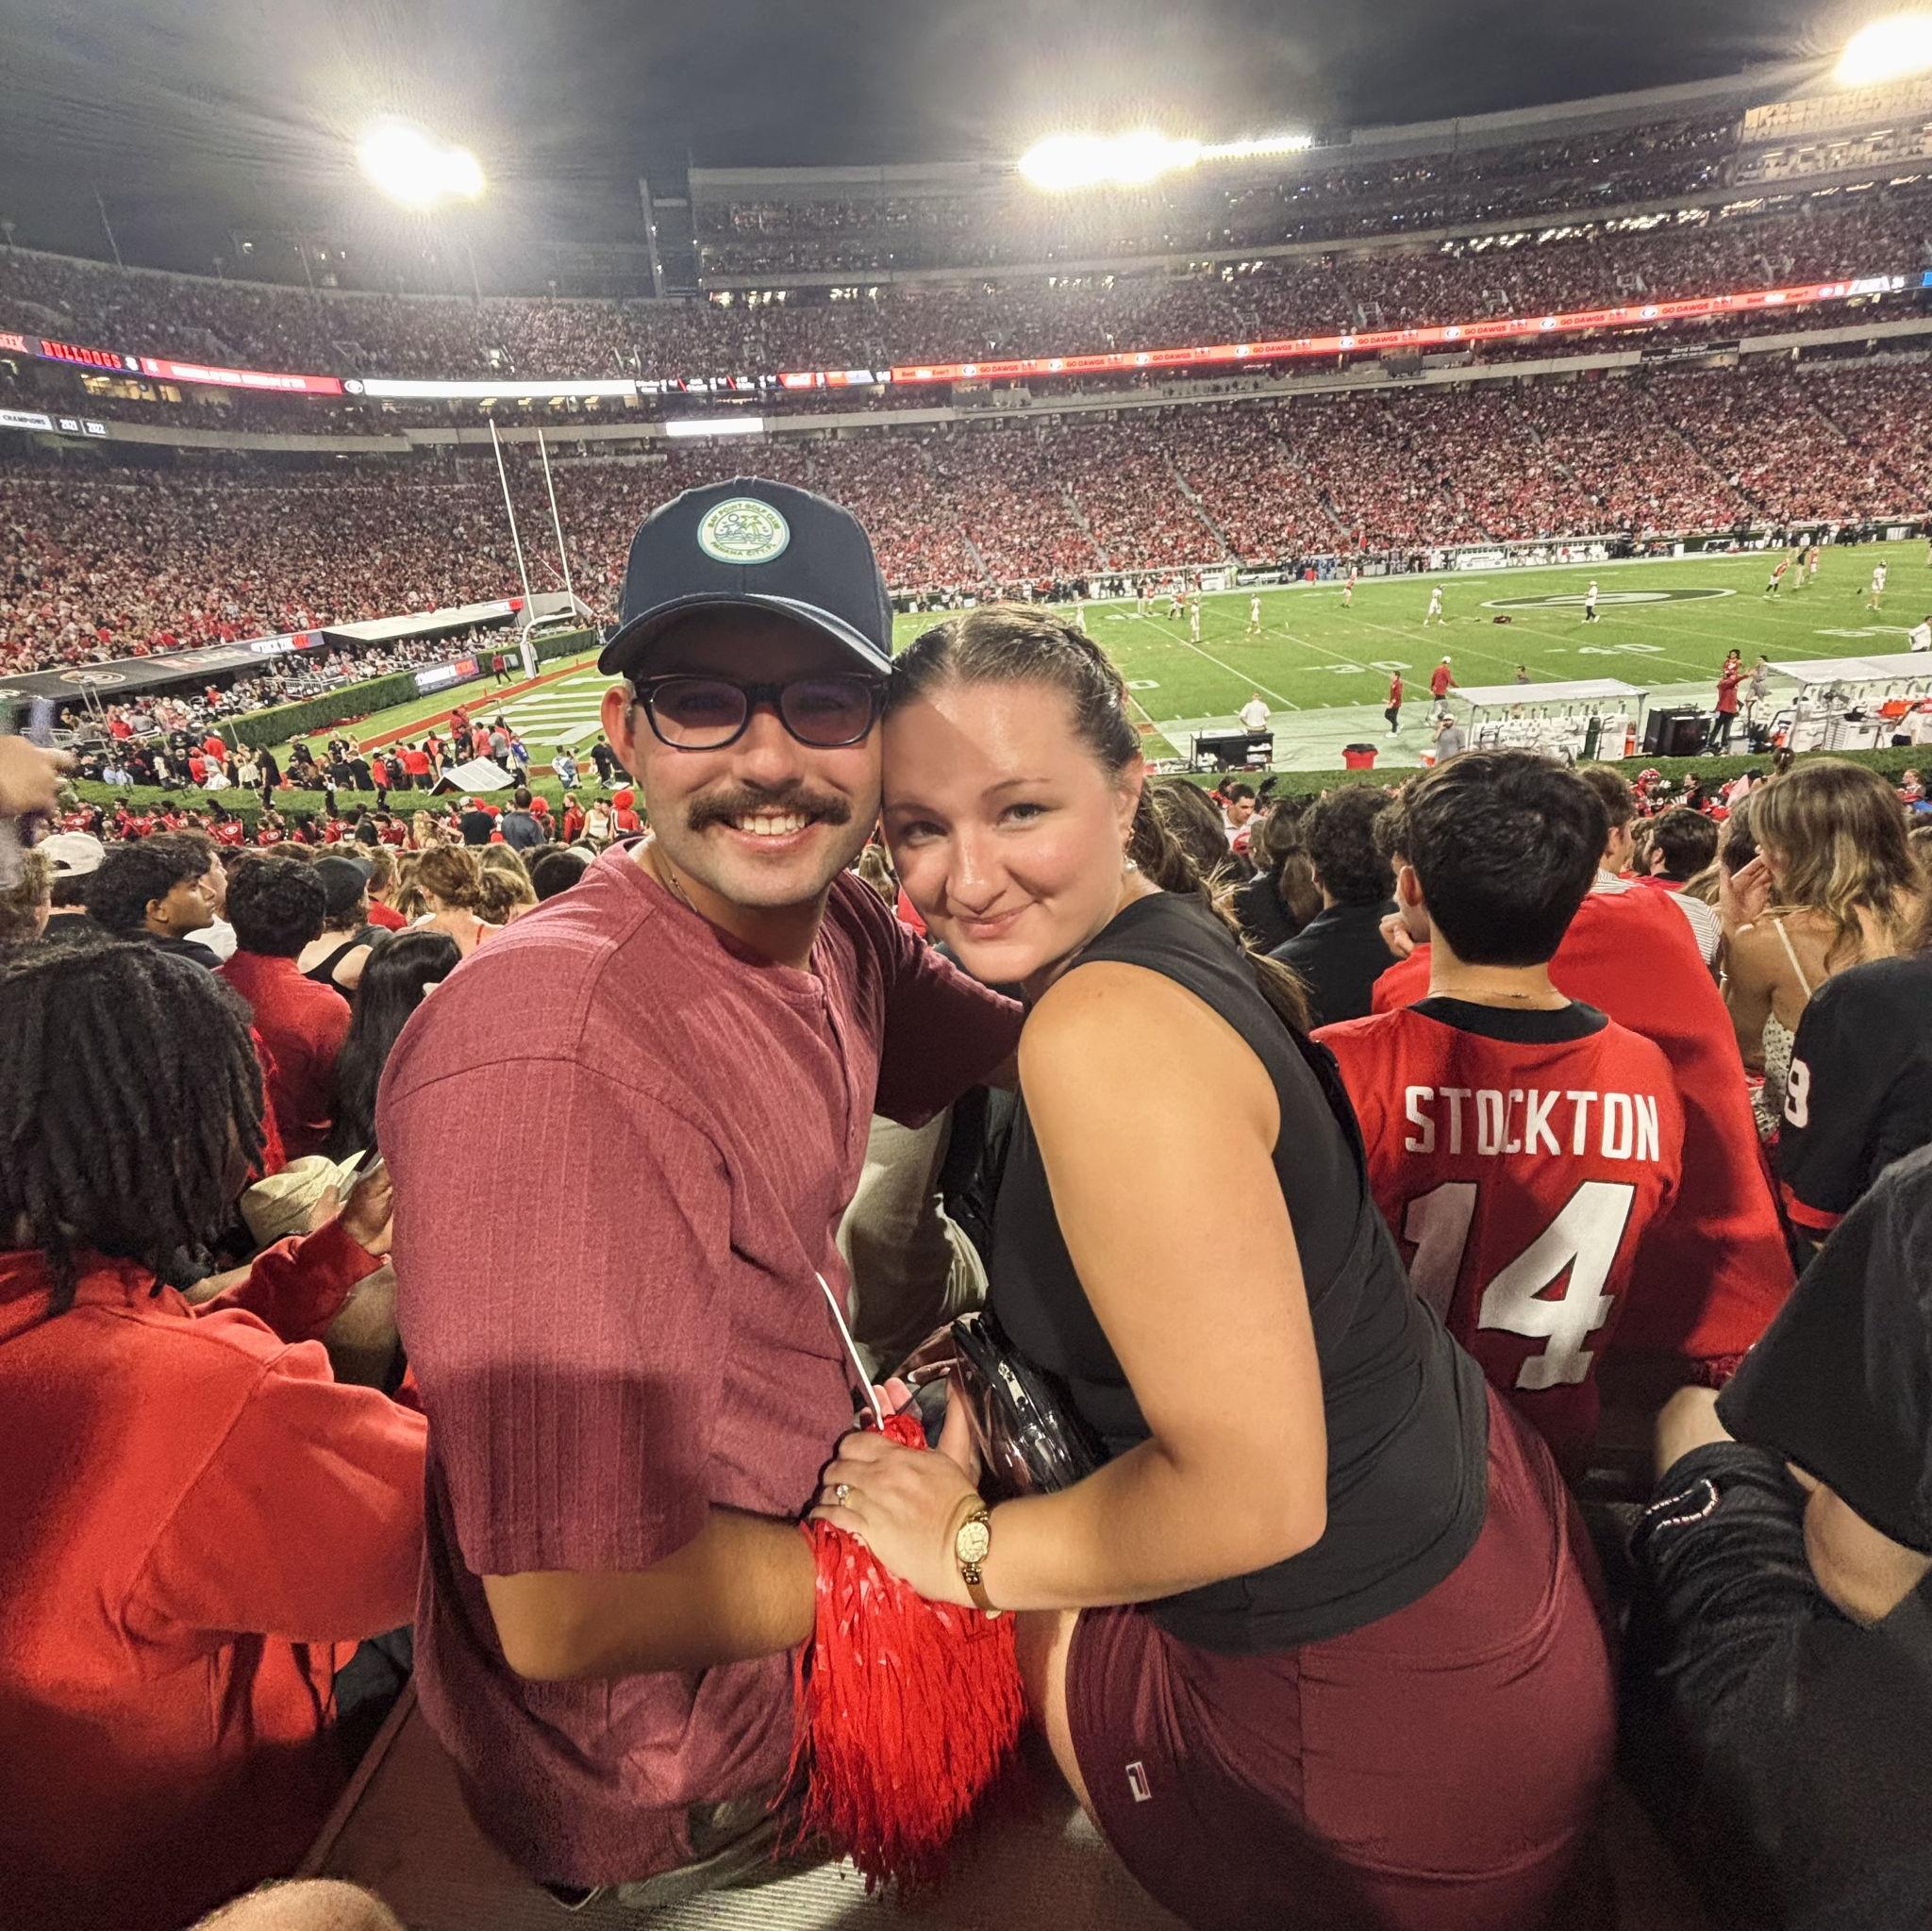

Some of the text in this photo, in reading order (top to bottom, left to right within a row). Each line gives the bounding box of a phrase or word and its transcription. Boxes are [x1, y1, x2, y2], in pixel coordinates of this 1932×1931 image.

[1676, 302, 1709, 312] DAWGS
[1574, 315, 1605, 324] DAWGS
[1477, 325, 1507, 334] DAWGS
[1371, 335, 1398, 343] DAWGS
[41, 340, 122, 369] BULLDOGS
[2, 414, 47, 424] CHAMPIONS
[708, 503, 780, 529] BAY POINT GOLF CLUB
[710, 541, 743, 556] PANAMA
[1577, 643, 1666, 655] 40
[1324, 660, 1413, 674] 30
[1404, 1085, 1660, 1162] STOCKTON
[1404, 1180, 1635, 1390] 14
